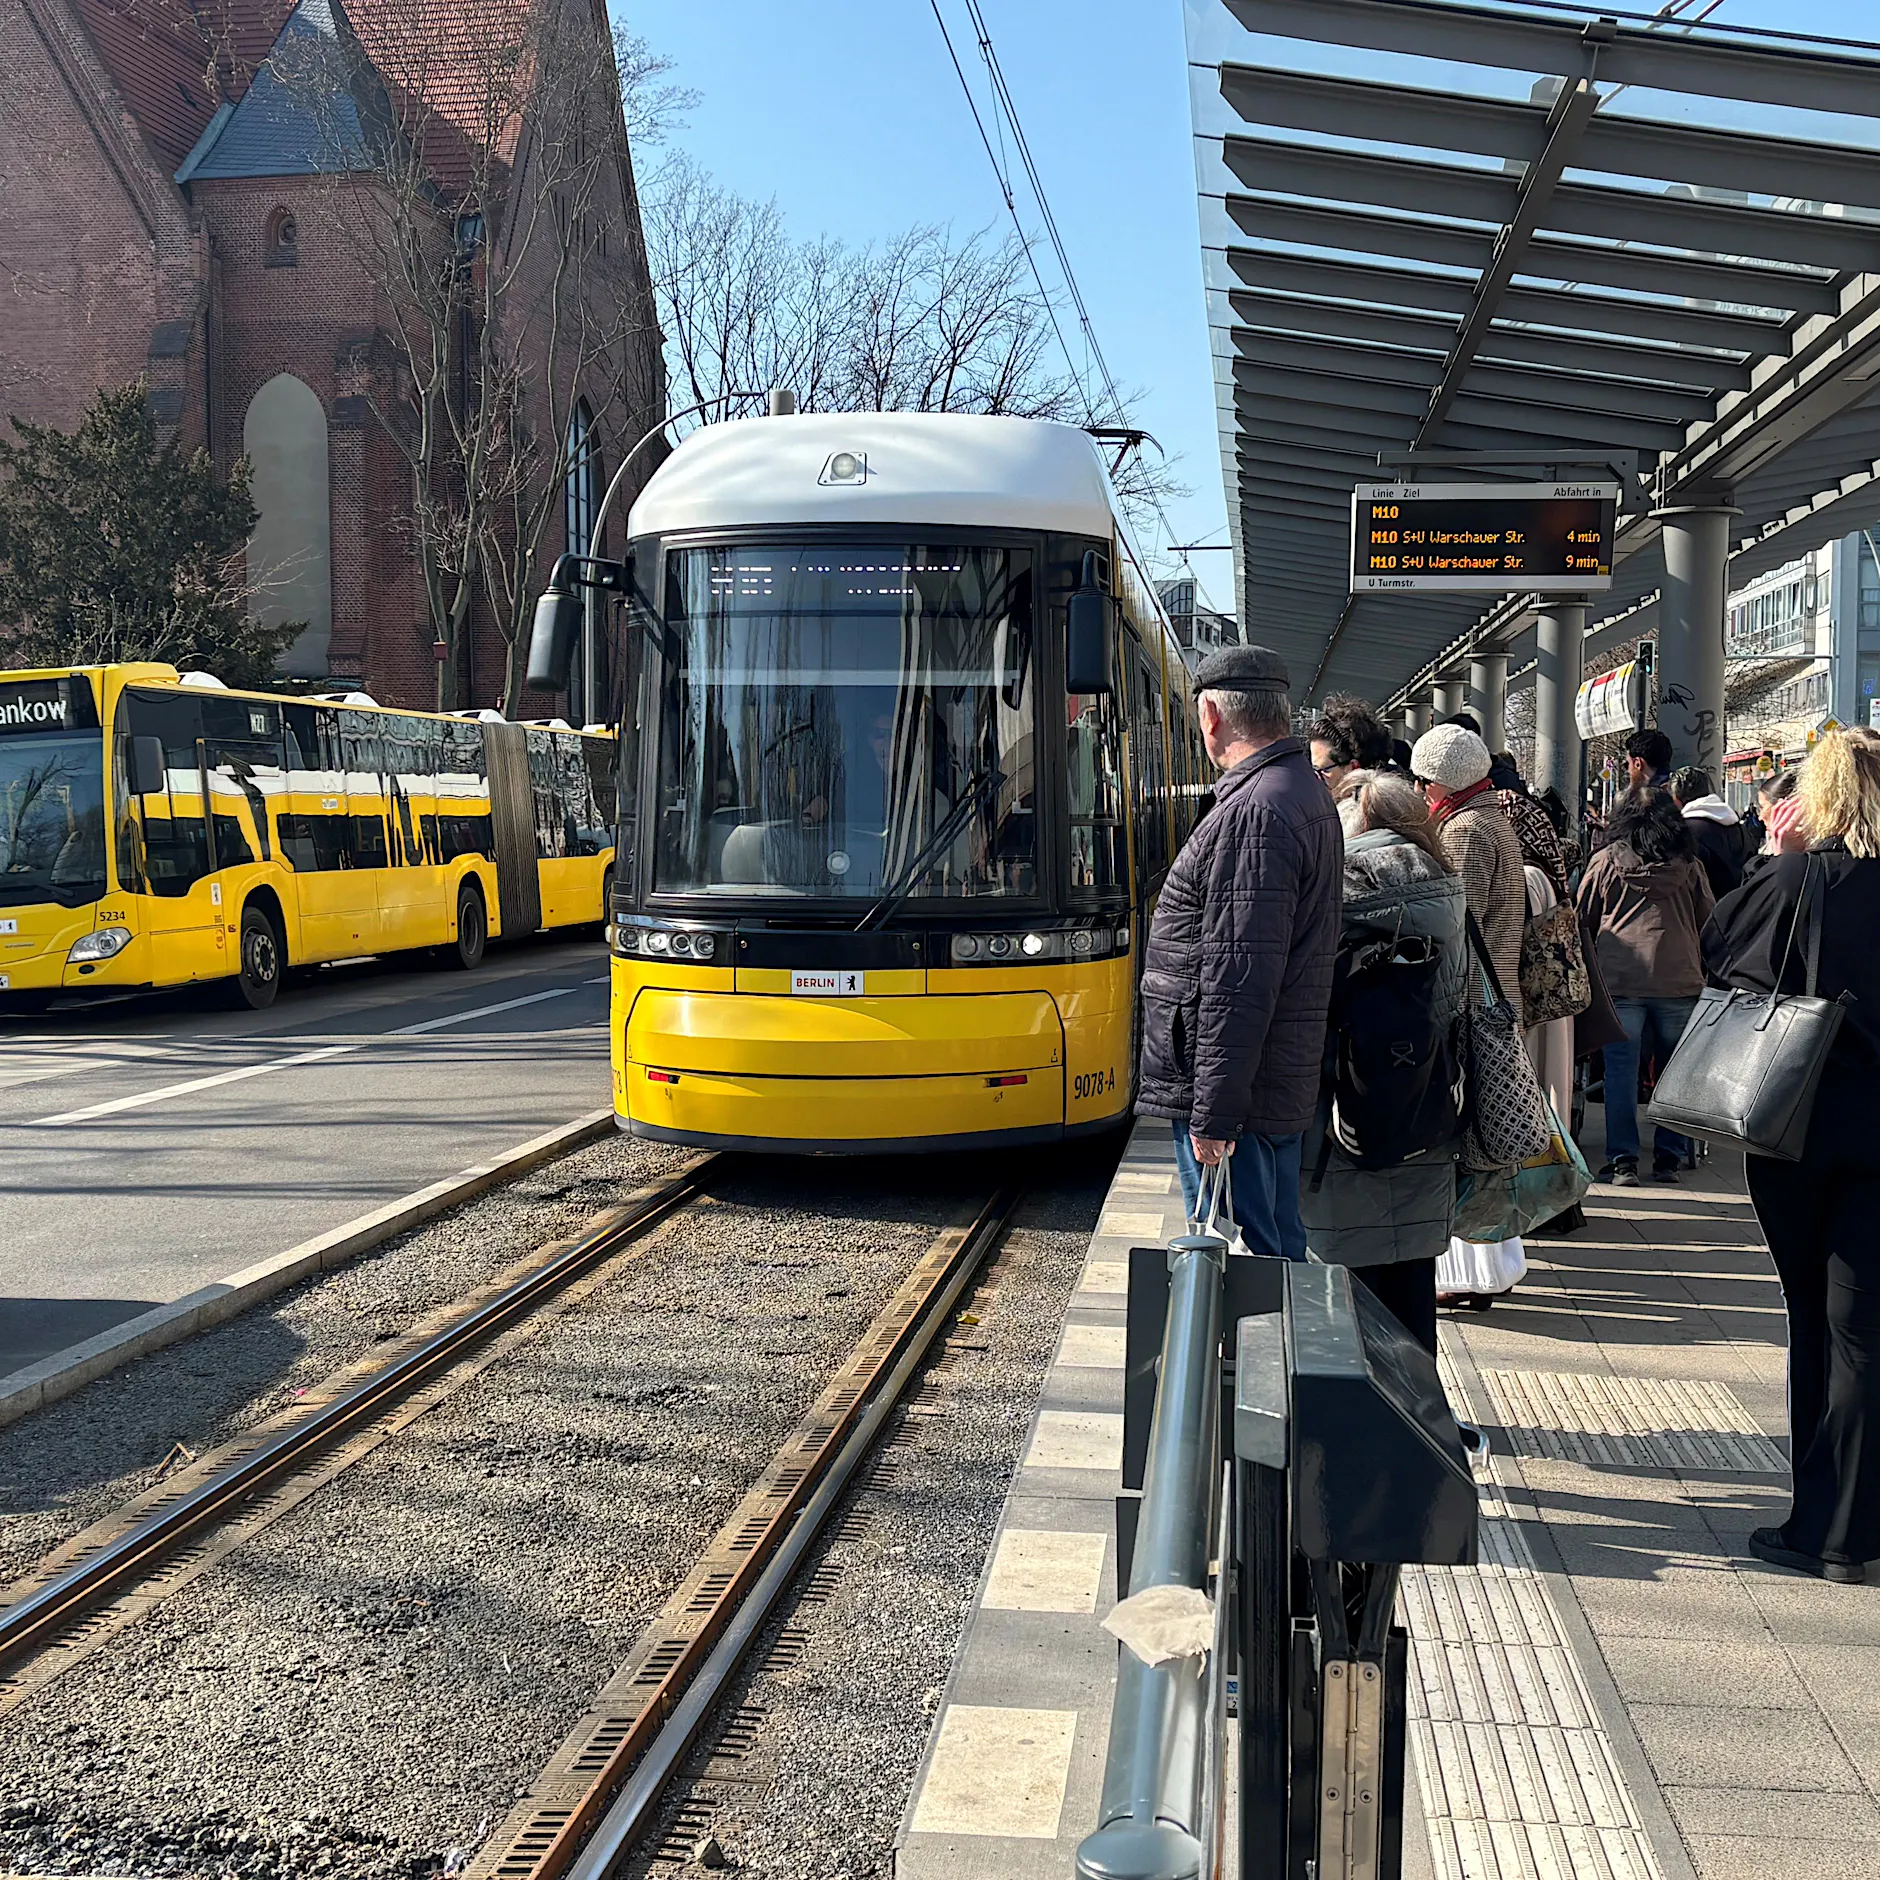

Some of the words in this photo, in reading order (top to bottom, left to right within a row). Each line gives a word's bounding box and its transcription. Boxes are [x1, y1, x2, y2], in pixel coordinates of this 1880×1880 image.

[1372, 488, 1394, 498] Linie
[1403, 488, 1420, 498] Ziel
[1553, 487, 1590, 497] Abfahrt
[1592, 487, 1601, 497] in
[1372, 505, 1399, 519] M10
[1371, 530, 1398, 544] M10
[1402, 530, 1425, 544] S+U
[1429, 530, 1500, 544] Warschauer
[1505, 530, 1525, 543] Str.
[1567, 530, 1575, 543] 4
[1577, 530, 1601, 543] min
[1370, 555, 1397, 569] M10
[1401, 555, 1424, 569] S+U
[1428, 555, 1499, 569] Warschauer
[1503, 555, 1524, 568] Str.
[1565, 555, 1574, 568] 9
[1575, 555, 1599, 568] min
[1368, 578, 1375, 587] U
[1378, 578, 1416, 588] Turmstr.
[99, 910, 126, 922] 5234
[796, 977, 835, 988] BERLIN
[1073, 1066, 1115, 1100] 9078-A
